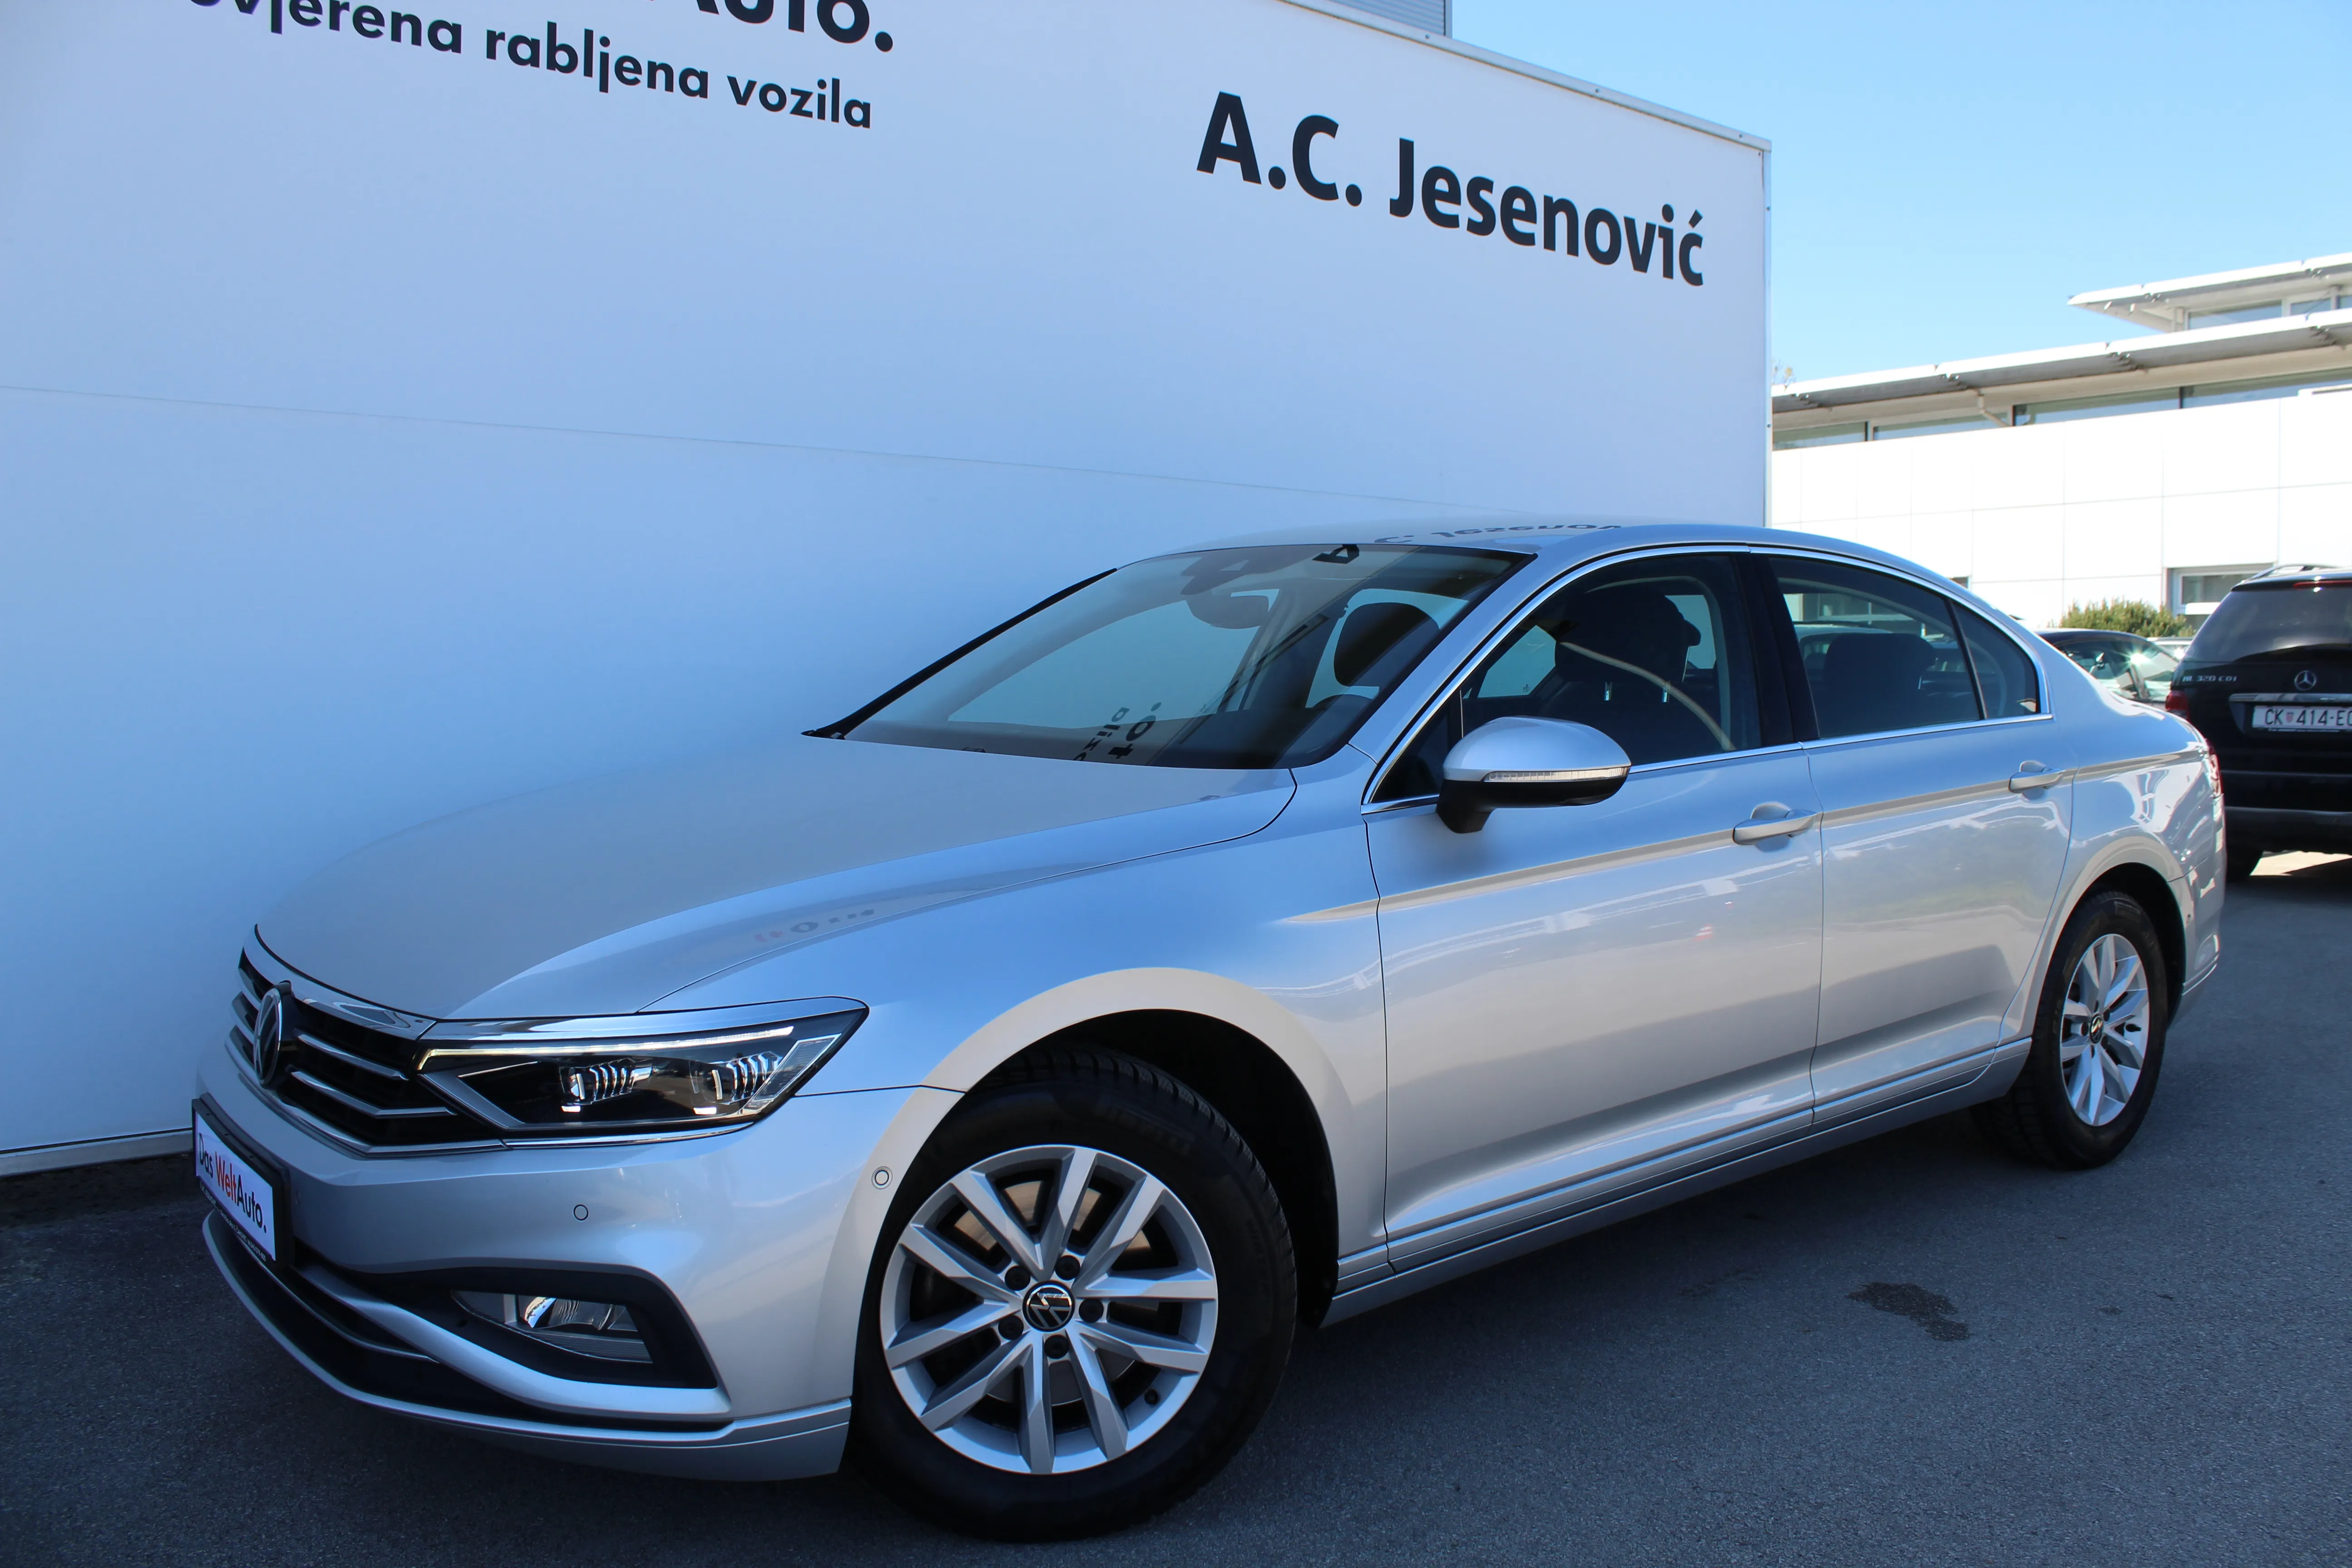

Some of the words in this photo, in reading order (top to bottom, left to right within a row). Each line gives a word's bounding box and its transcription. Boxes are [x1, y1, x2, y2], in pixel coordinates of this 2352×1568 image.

[190, 0, 462, 54] jerena
[486, 21, 709, 99] rabljena
[727, 76, 871, 129] vozila
[1196, 92, 1362, 207] A.C.
[1389, 138, 1703, 286] Jesenović
[2265, 709, 2284, 725] CK
[199, 1132, 213, 1178] Das
[215, 1151, 267, 1234] WeltAuto.
